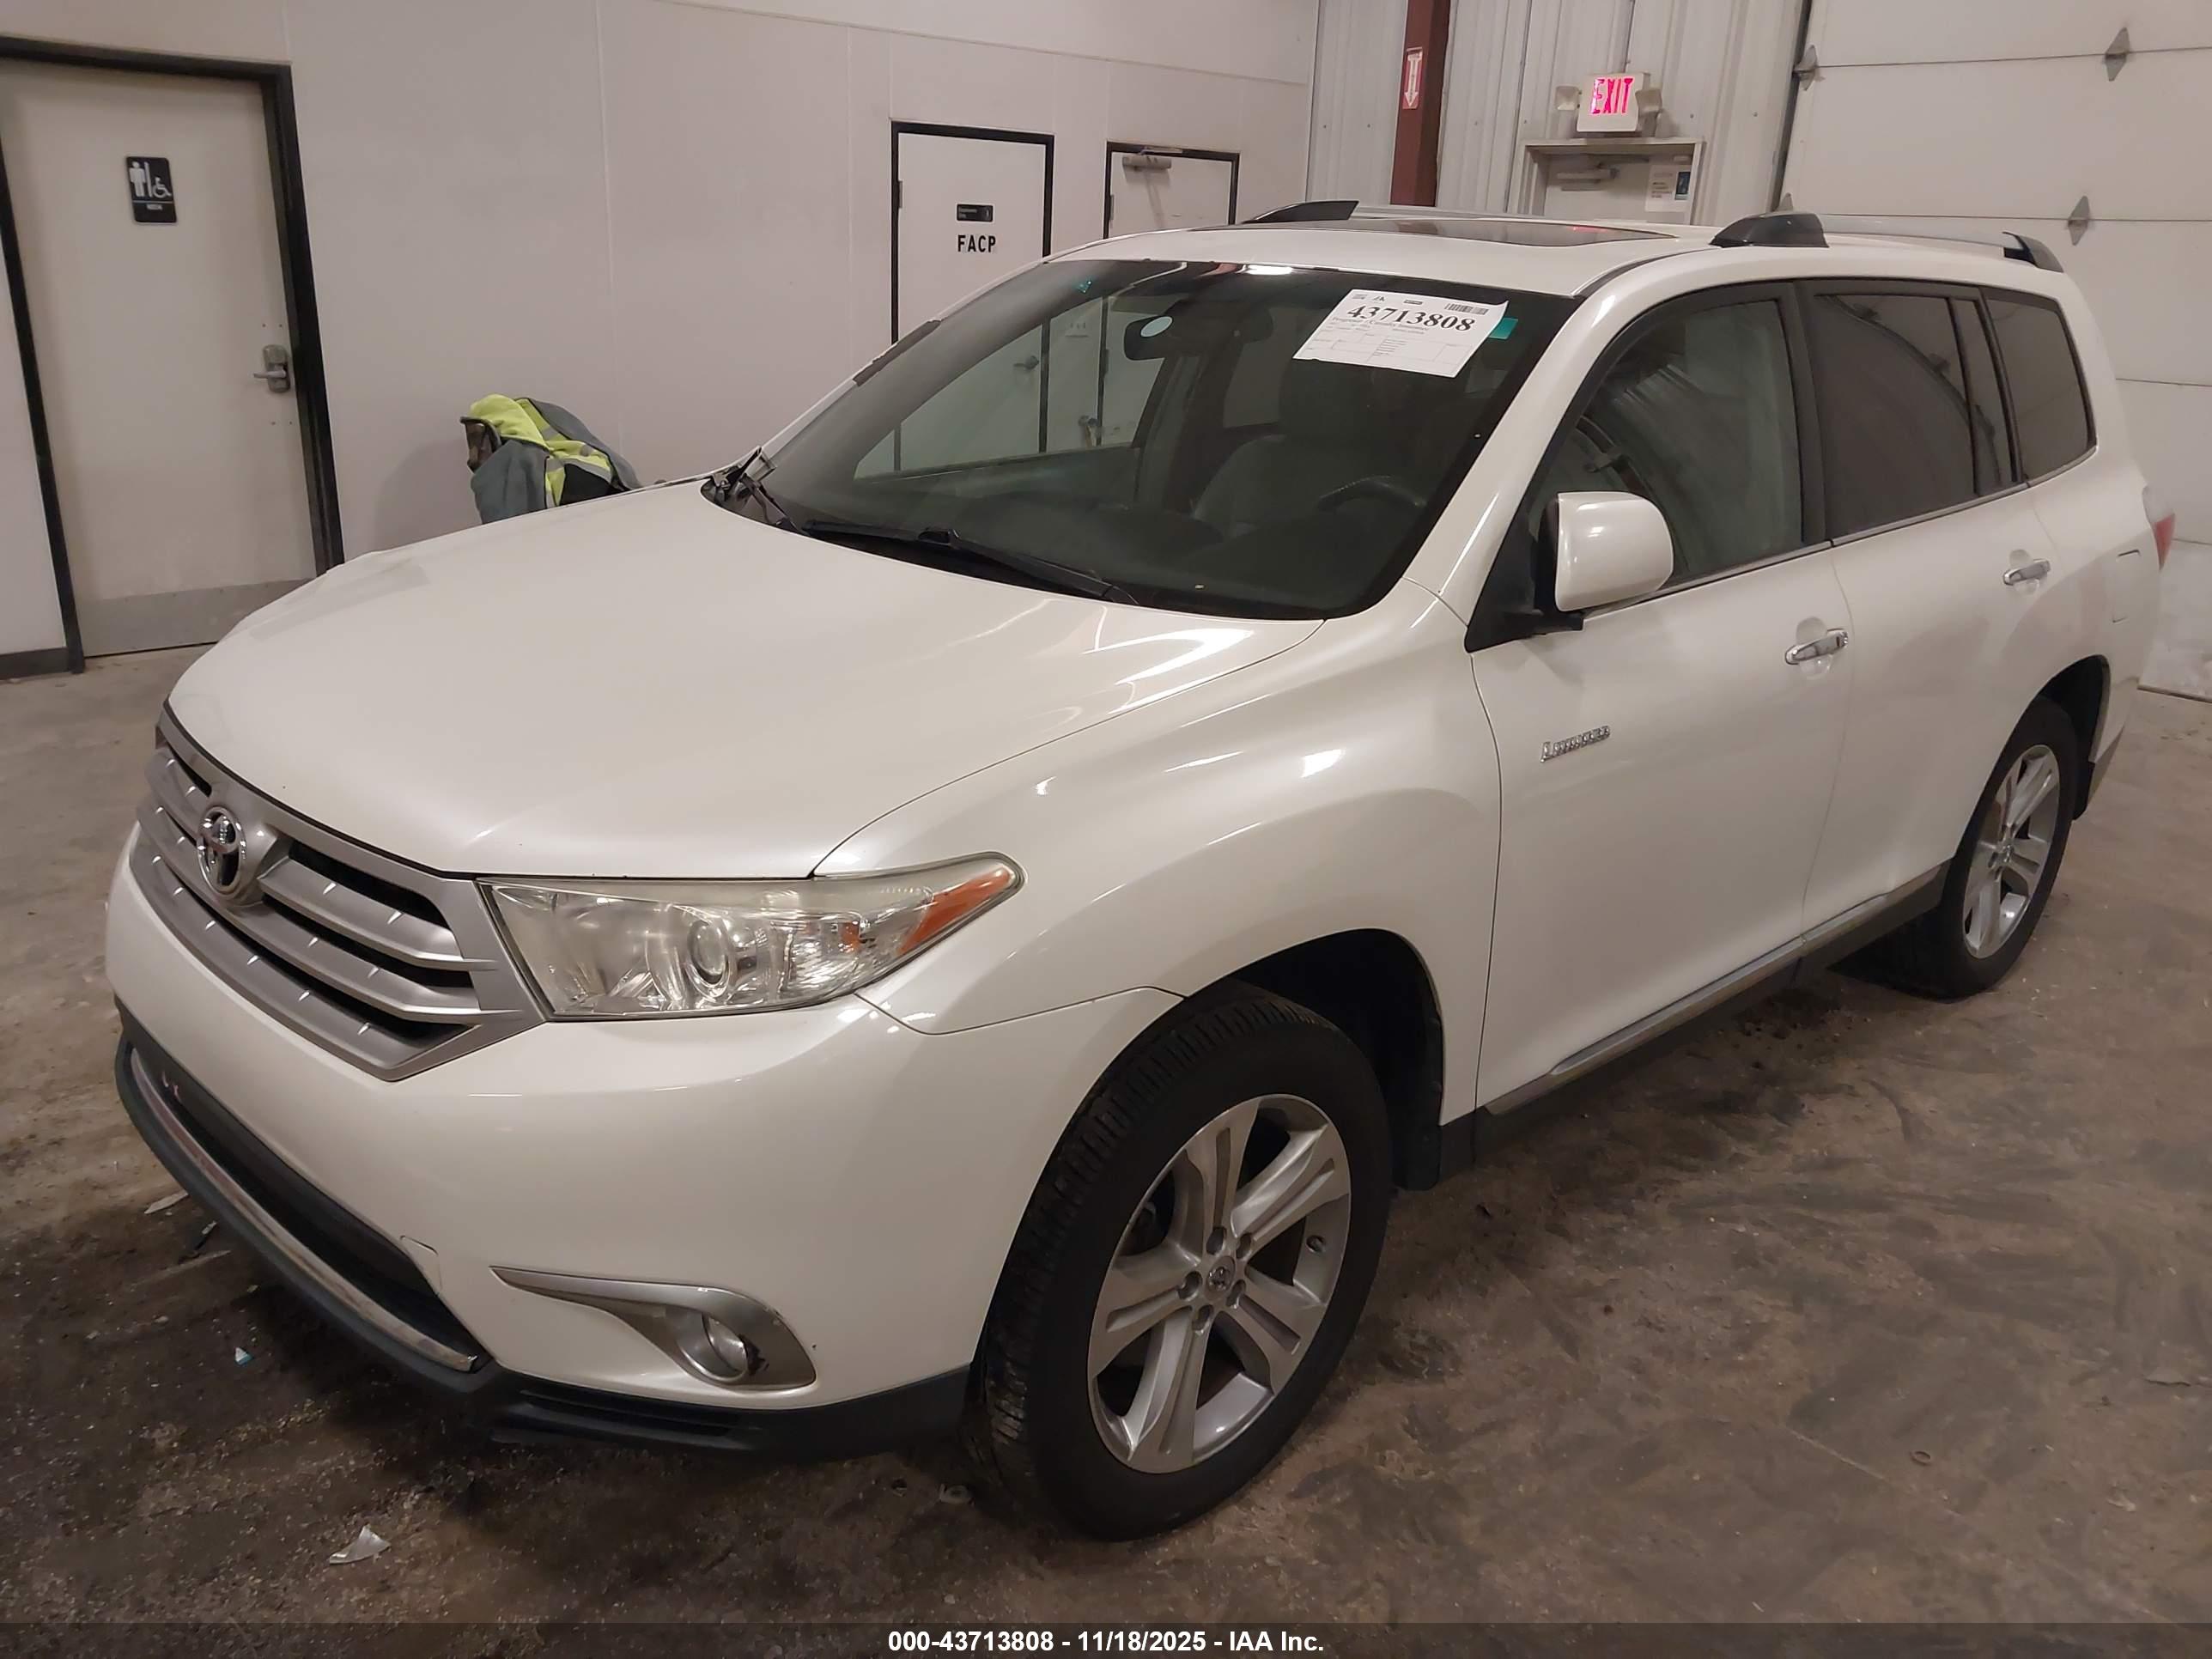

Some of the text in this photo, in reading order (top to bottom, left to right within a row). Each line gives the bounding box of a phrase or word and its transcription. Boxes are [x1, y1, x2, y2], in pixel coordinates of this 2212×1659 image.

[1591, 78, 1633, 114] EXIT
[957, 234, 996, 252] FACP
[1347, 305, 1475, 331] 43713808
